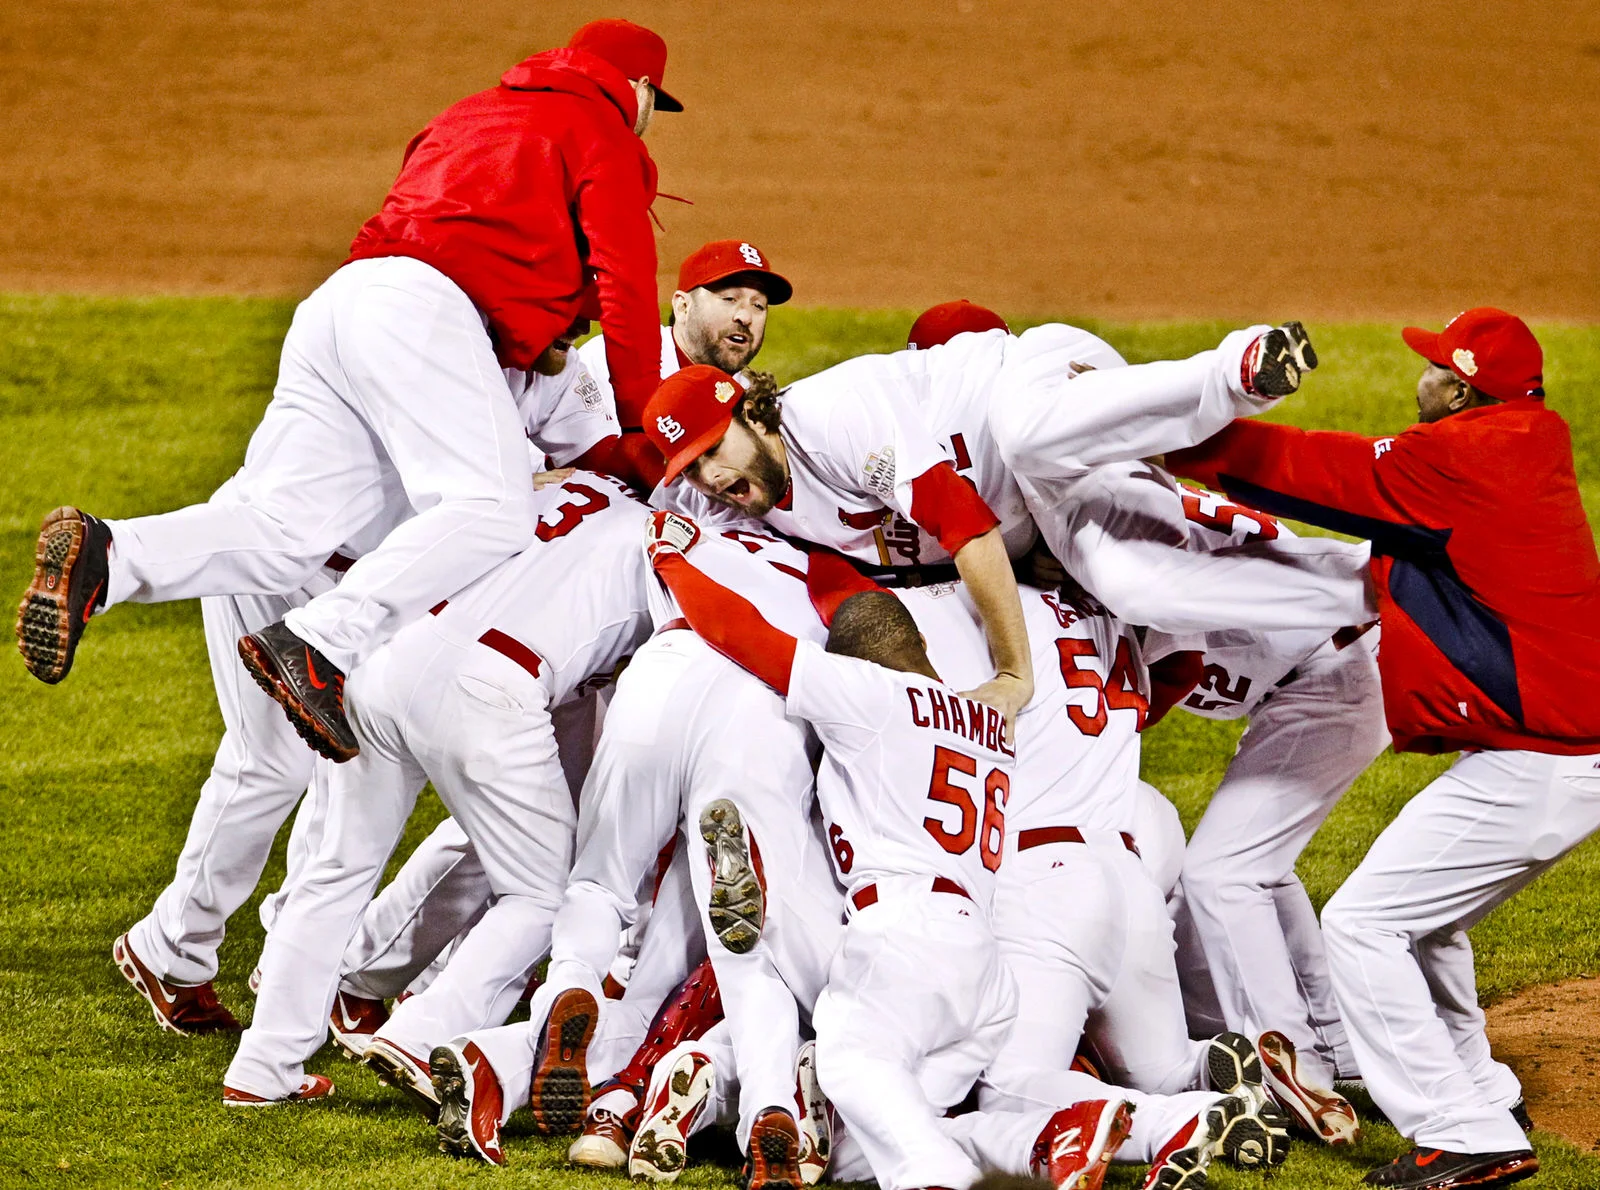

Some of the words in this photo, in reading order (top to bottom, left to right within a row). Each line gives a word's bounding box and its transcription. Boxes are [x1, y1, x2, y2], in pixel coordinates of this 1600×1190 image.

[1054, 634, 1150, 737] 54
[828, 822, 855, 875] 6
[922, 744, 1011, 874] 56
